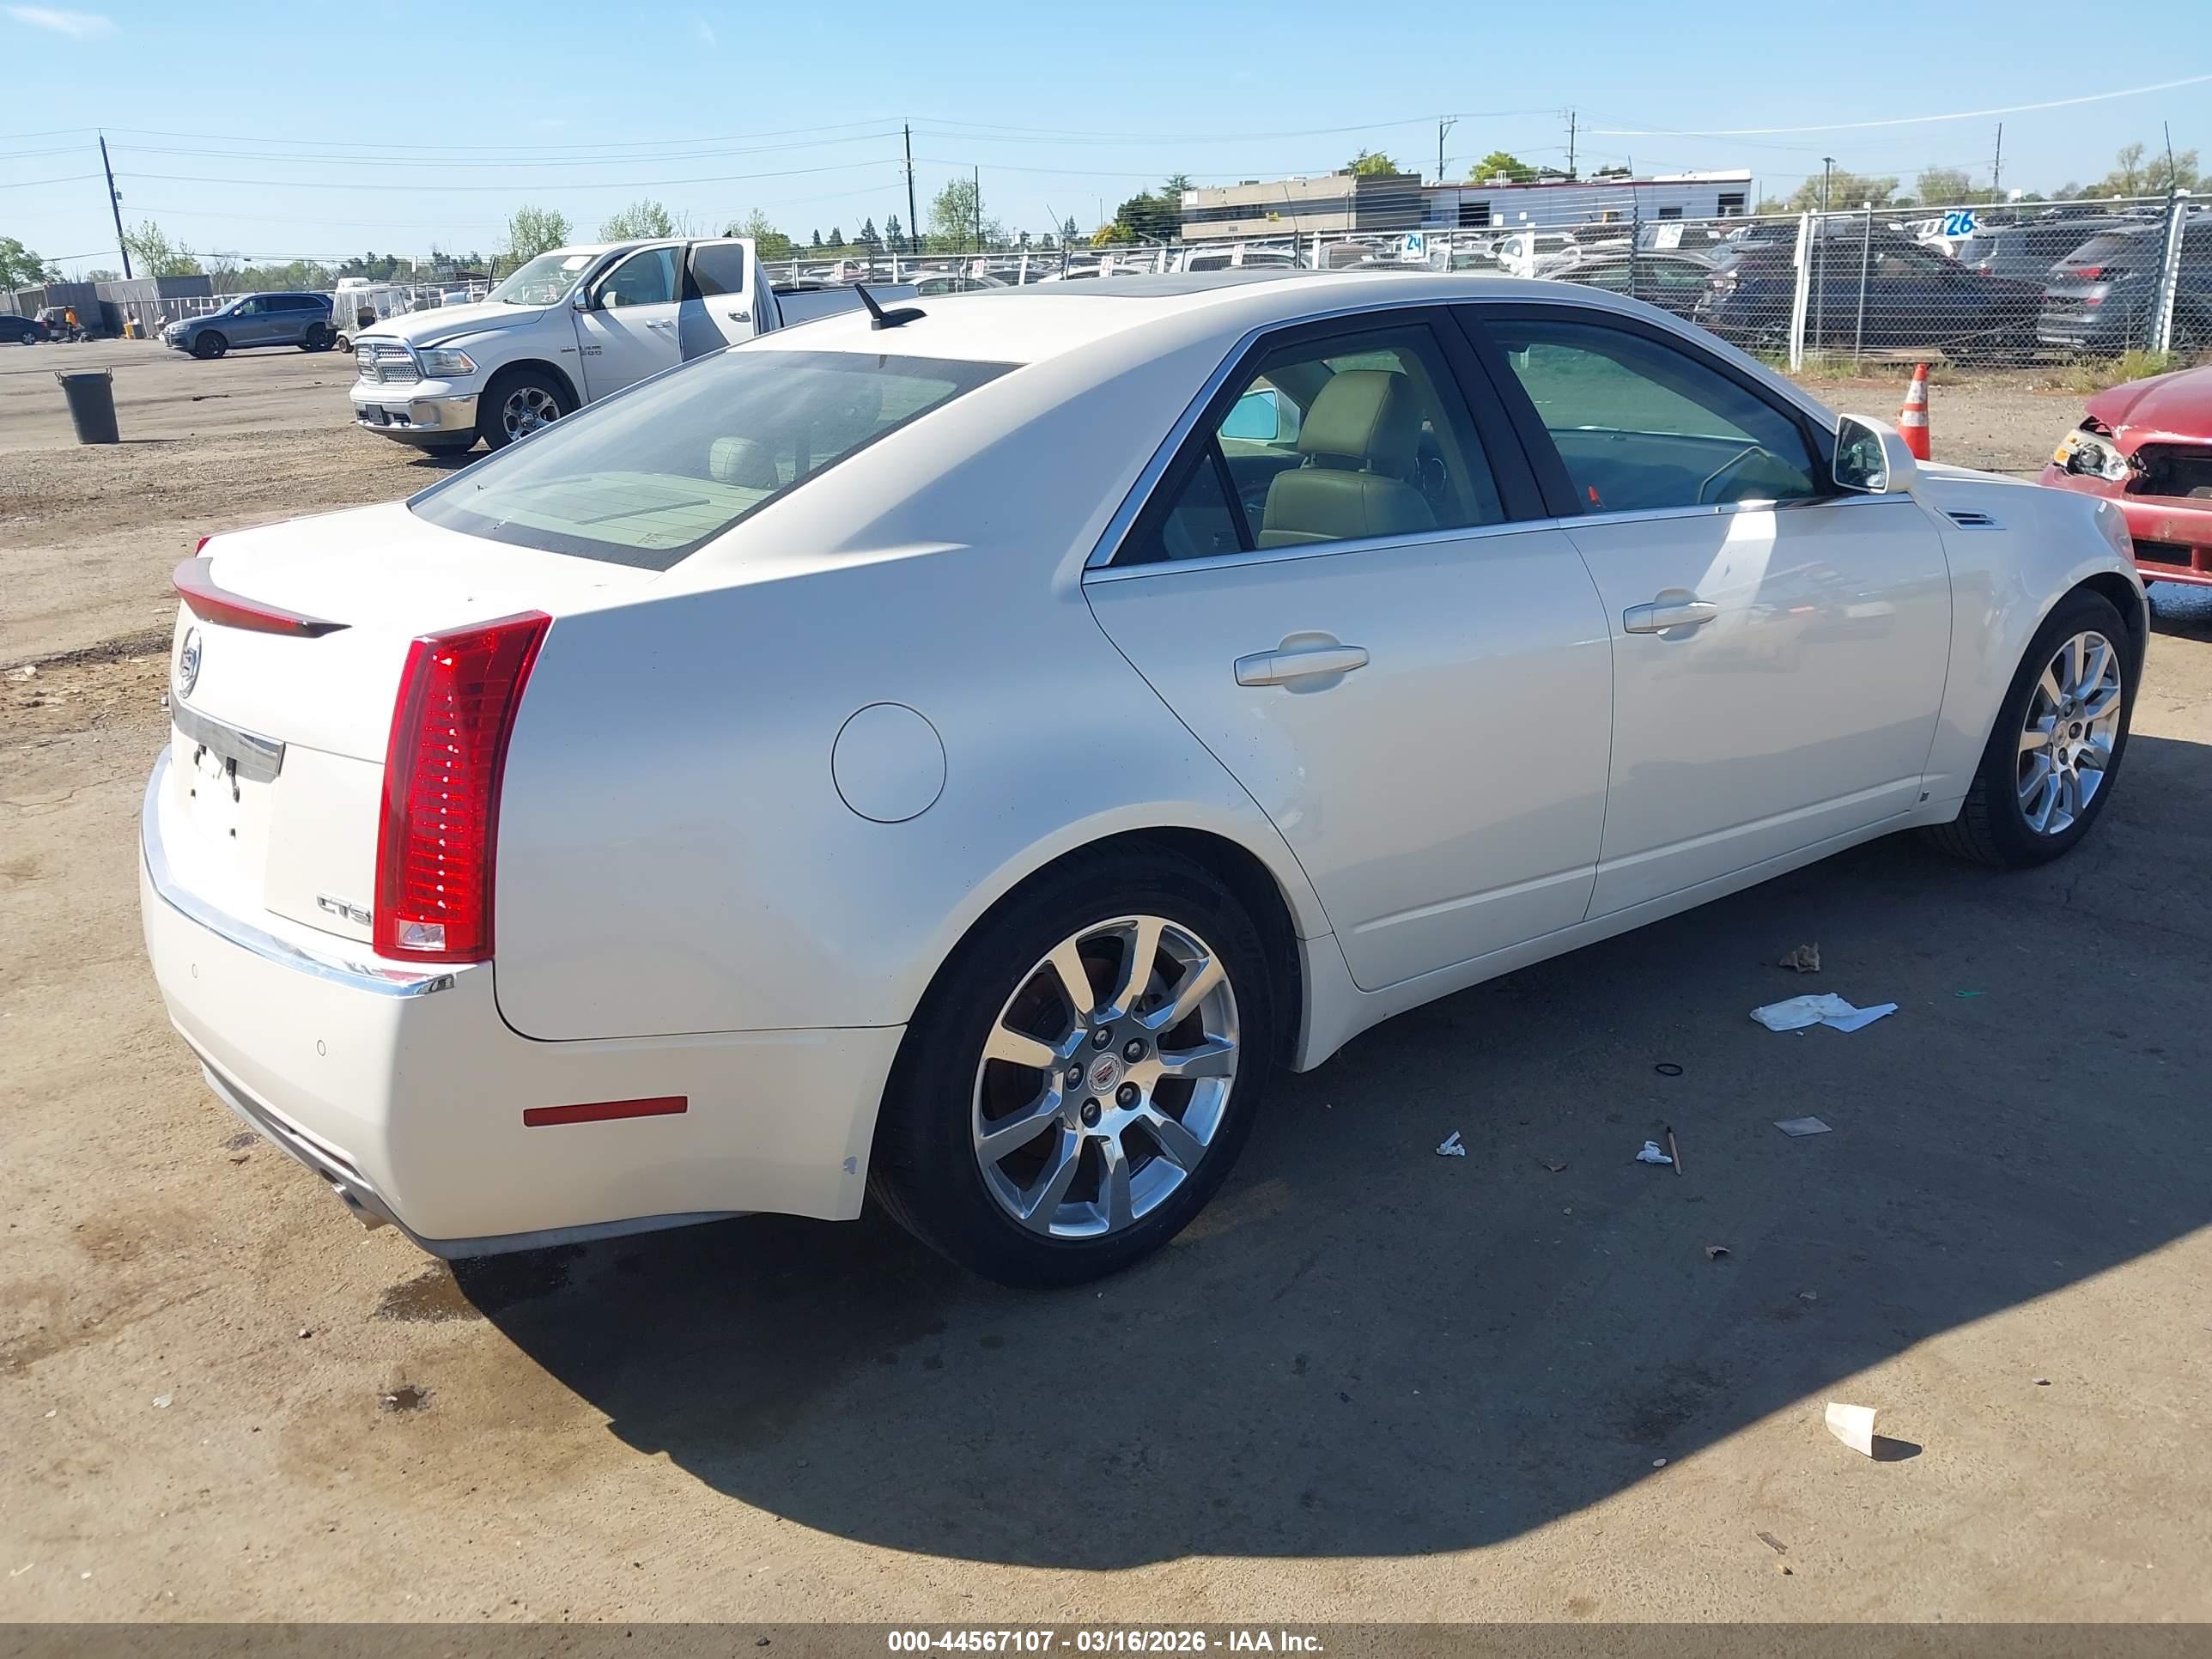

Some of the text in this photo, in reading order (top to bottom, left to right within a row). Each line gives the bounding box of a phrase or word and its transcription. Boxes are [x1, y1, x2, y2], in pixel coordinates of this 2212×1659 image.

[1945, 210, 1978, 235] 26
[1407, 234, 1421, 253] 24
[316, 893, 372, 927] CTS
